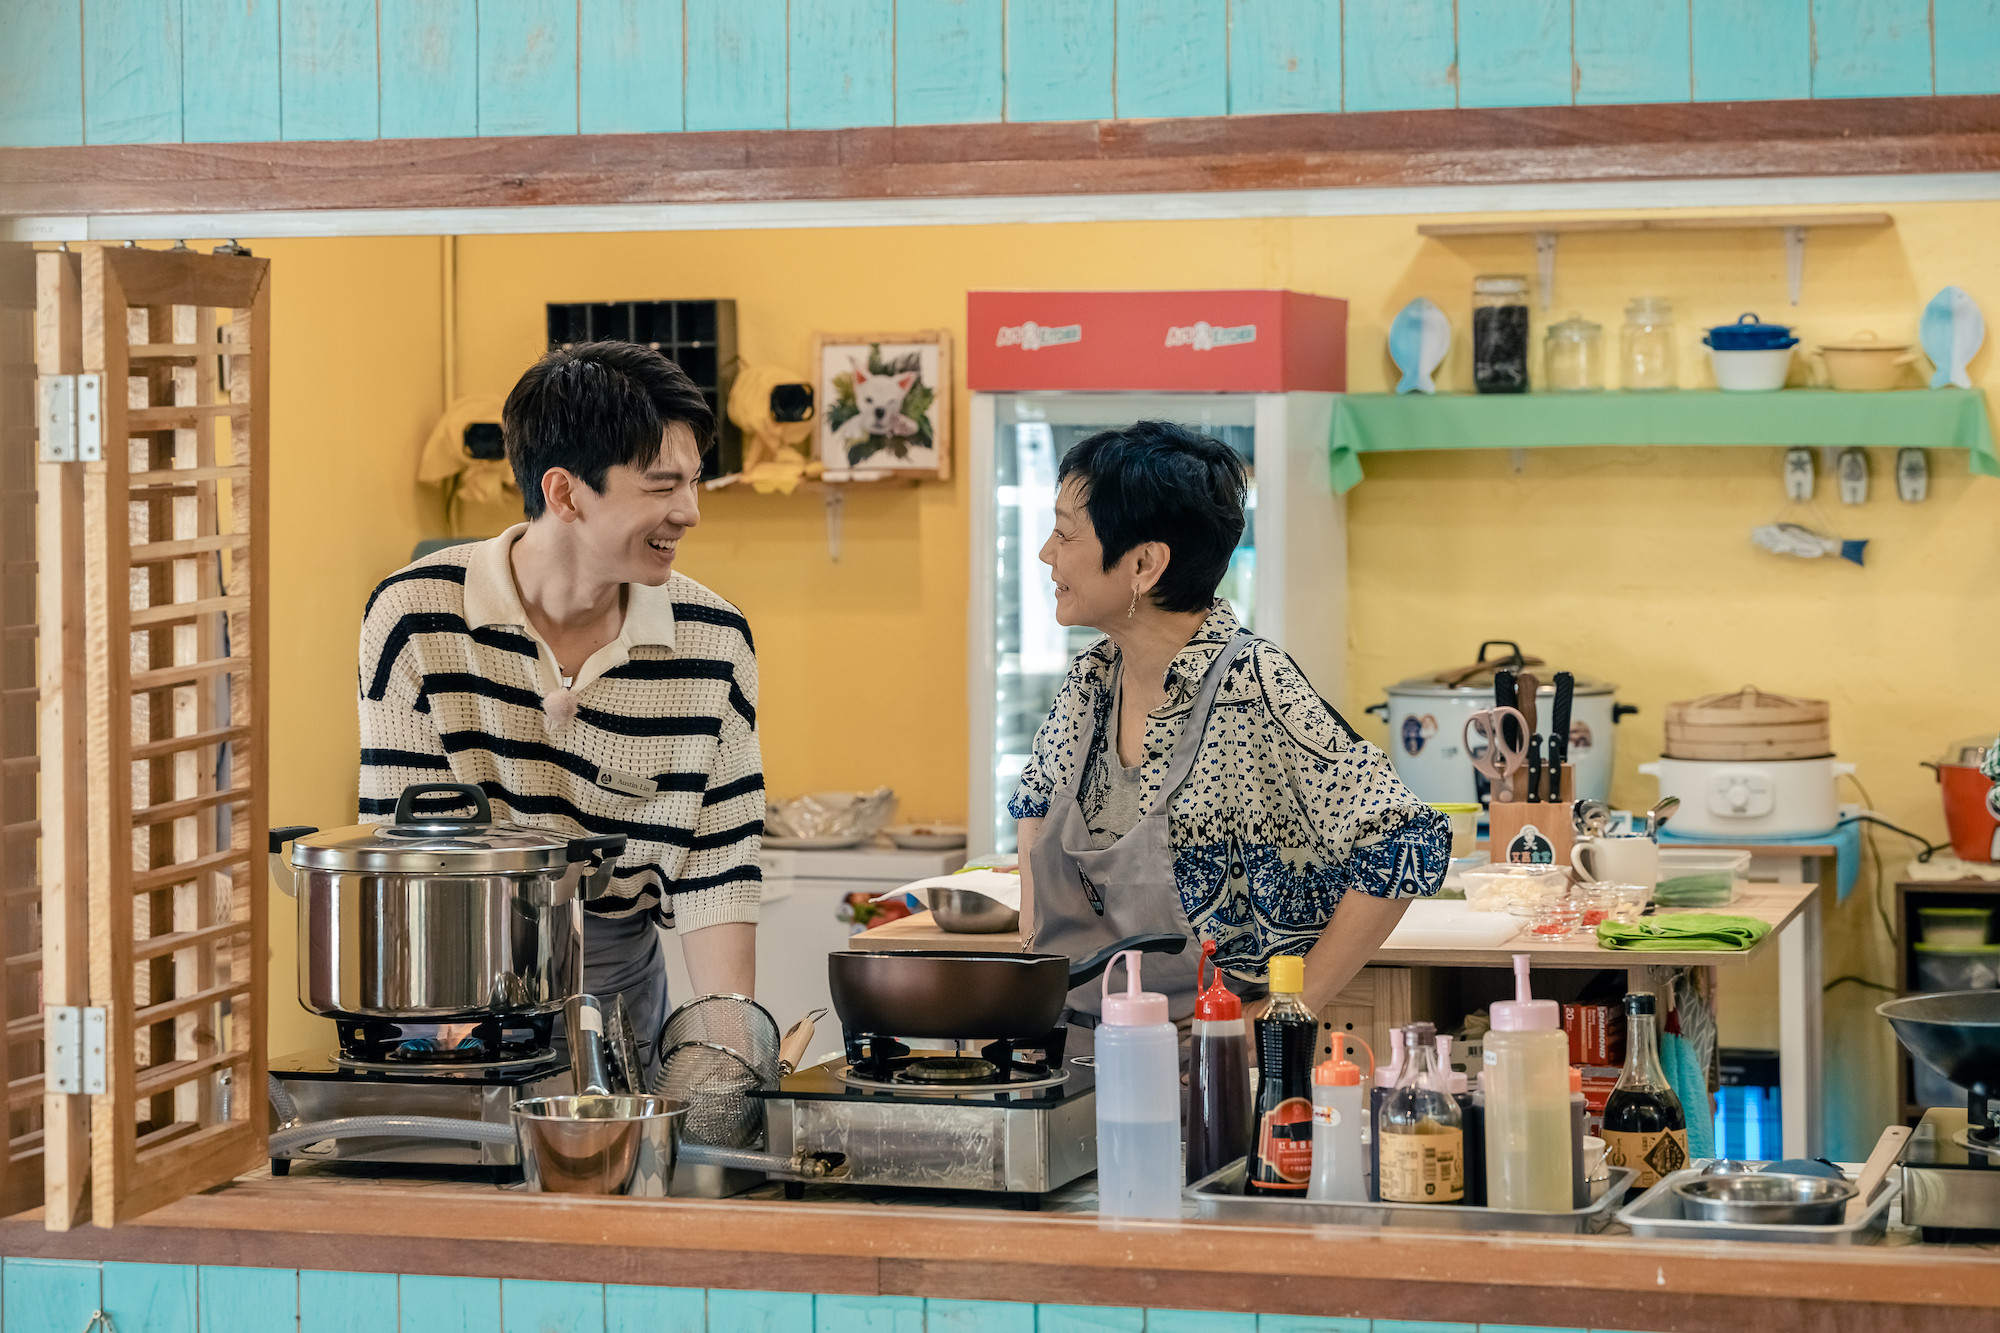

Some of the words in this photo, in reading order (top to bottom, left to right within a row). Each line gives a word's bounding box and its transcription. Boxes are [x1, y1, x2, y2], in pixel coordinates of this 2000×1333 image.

[617, 779, 638, 789] Austin
[639, 783, 650, 792] Lin
[1566, 1007, 1575, 1020] 20
[1598, 1011, 1606, 1059] DIAMOND
